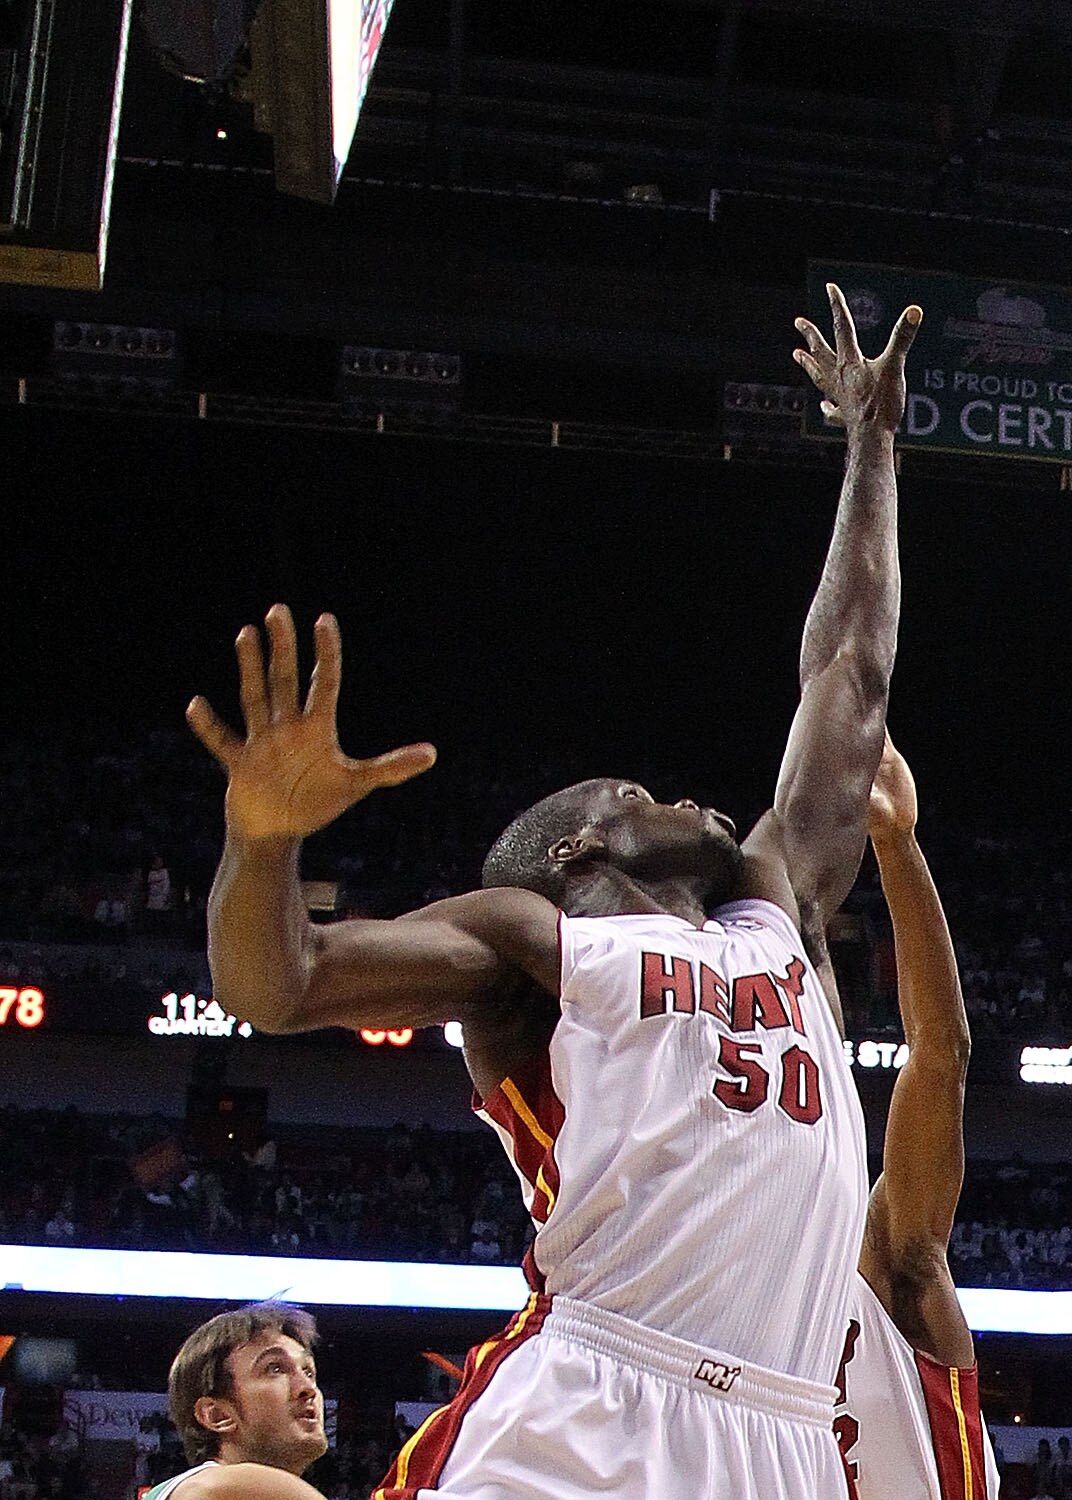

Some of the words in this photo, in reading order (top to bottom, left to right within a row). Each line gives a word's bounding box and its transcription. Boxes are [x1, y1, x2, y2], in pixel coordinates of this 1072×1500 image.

[924, 368, 945, 389] IS
[954, 373, 1038, 399] PROUD
[0, 984, 45, 1028] 78
[639, 950, 808, 1038] HEAT
[711, 1032, 824, 1126] 50
